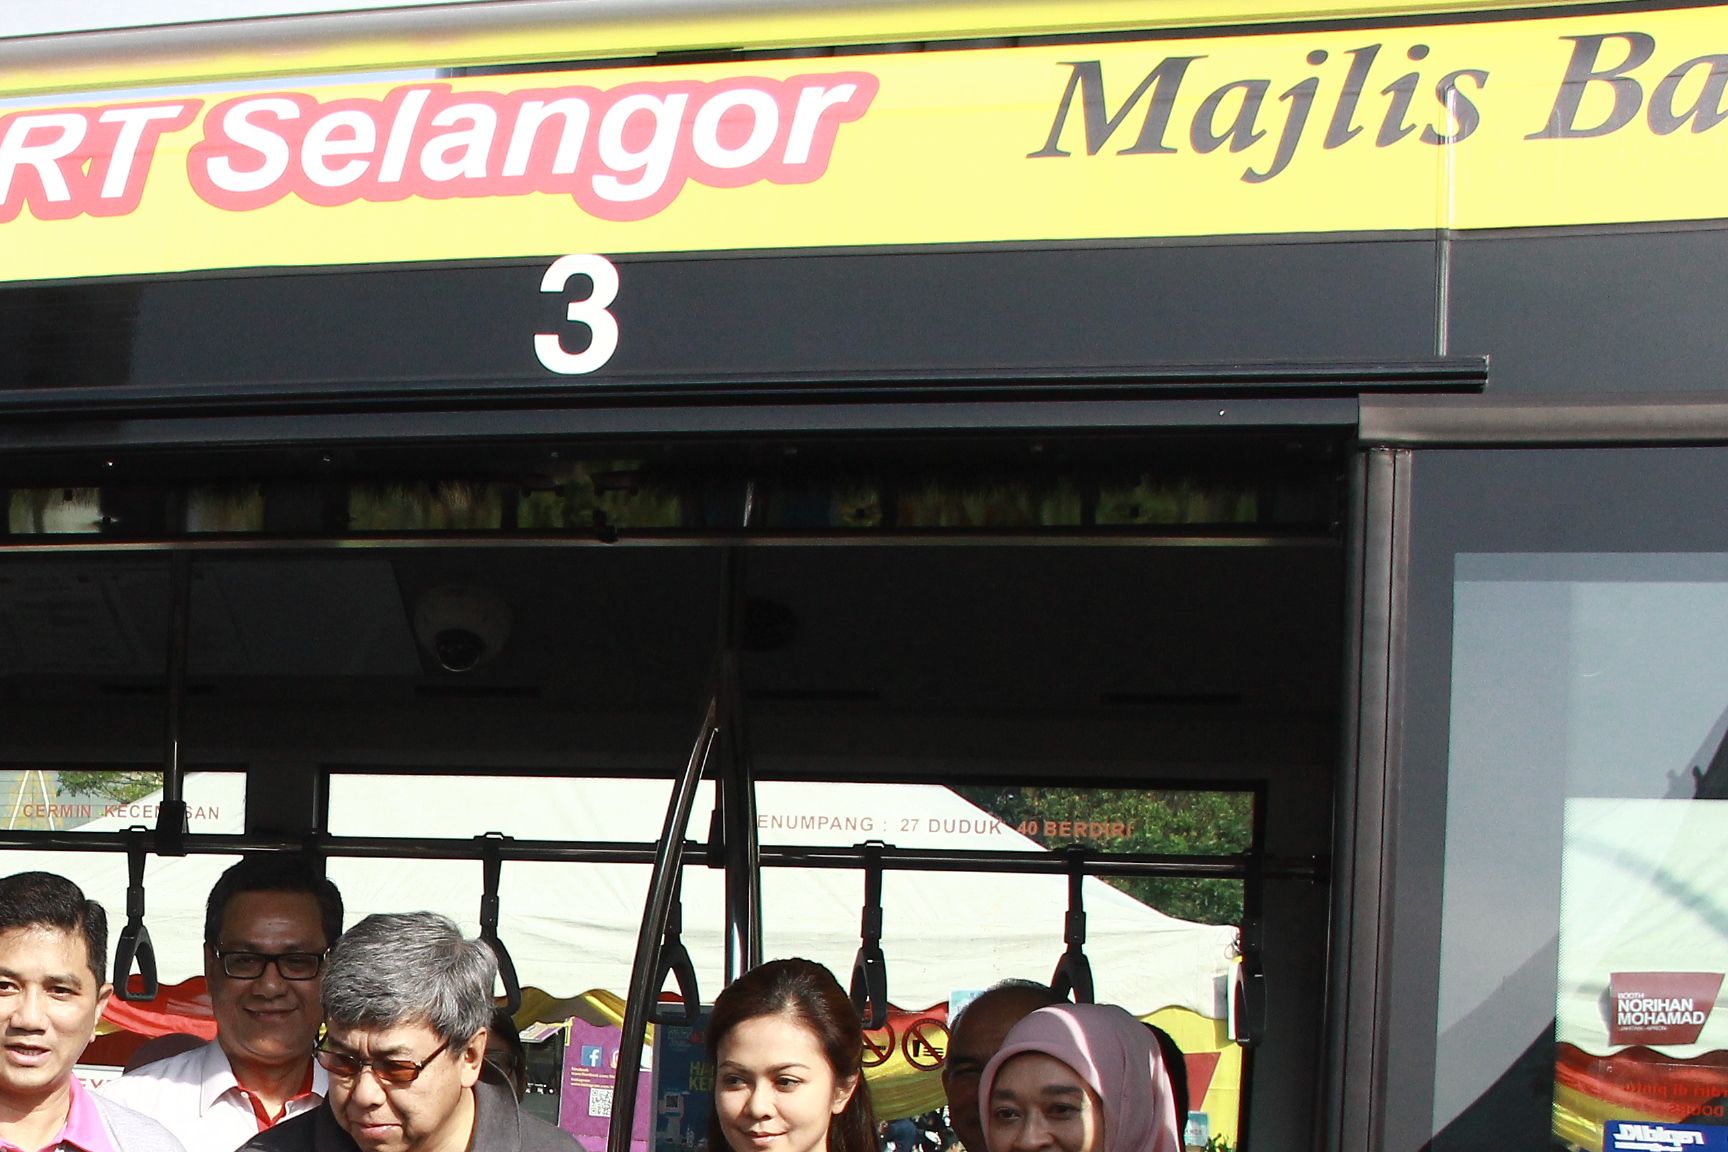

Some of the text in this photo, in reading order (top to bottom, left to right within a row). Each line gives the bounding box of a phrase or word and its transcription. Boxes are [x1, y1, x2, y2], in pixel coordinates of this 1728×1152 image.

[1027, 43, 1489, 184] Majlis
[204, 84, 858, 203] Selangor
[534, 254, 619, 374] 3
[23, 803, 220, 819] CERMIN KECESAN
[757, 814, 874, 832] ENUMPANG
[900, 818, 919, 832] 27
[929, 818, 1002, 835] DUDUK
[1017, 821, 1038, 836] 40
[1043, 821, 1133, 838] BERDIRI
[1618, 998, 1693, 1012] NORIHAN
[1618, 1011, 1705, 1025] MOHAMAD
